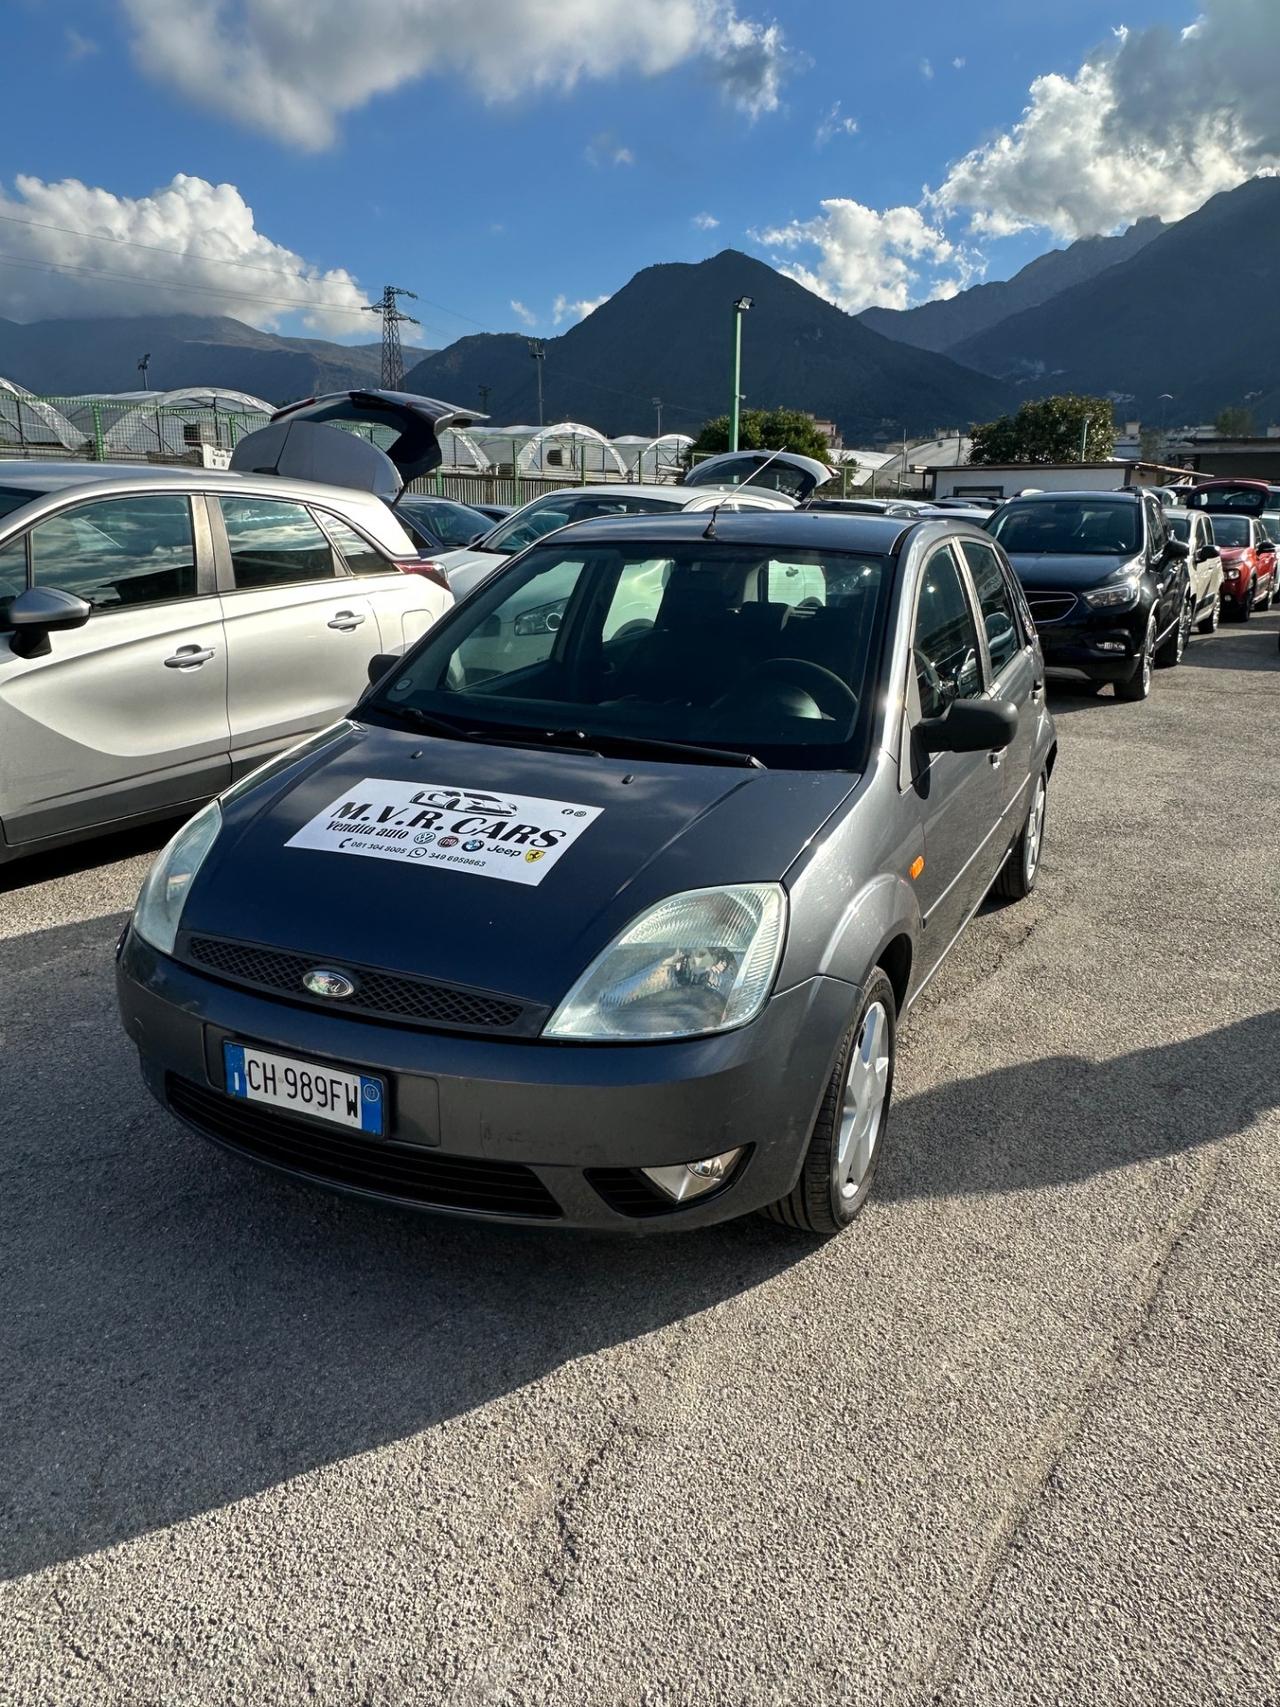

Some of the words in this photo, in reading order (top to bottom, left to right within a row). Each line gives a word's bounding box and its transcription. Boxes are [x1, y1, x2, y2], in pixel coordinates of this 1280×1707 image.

[326, 820, 374, 836] Vendita
[376, 828, 410, 840] auto
[350, 841, 367, 849] 081
[487, 845, 522, 858] Jeep
[247, 1059, 277, 1096] CH
[284, 1067, 359, 1118] 989FW
